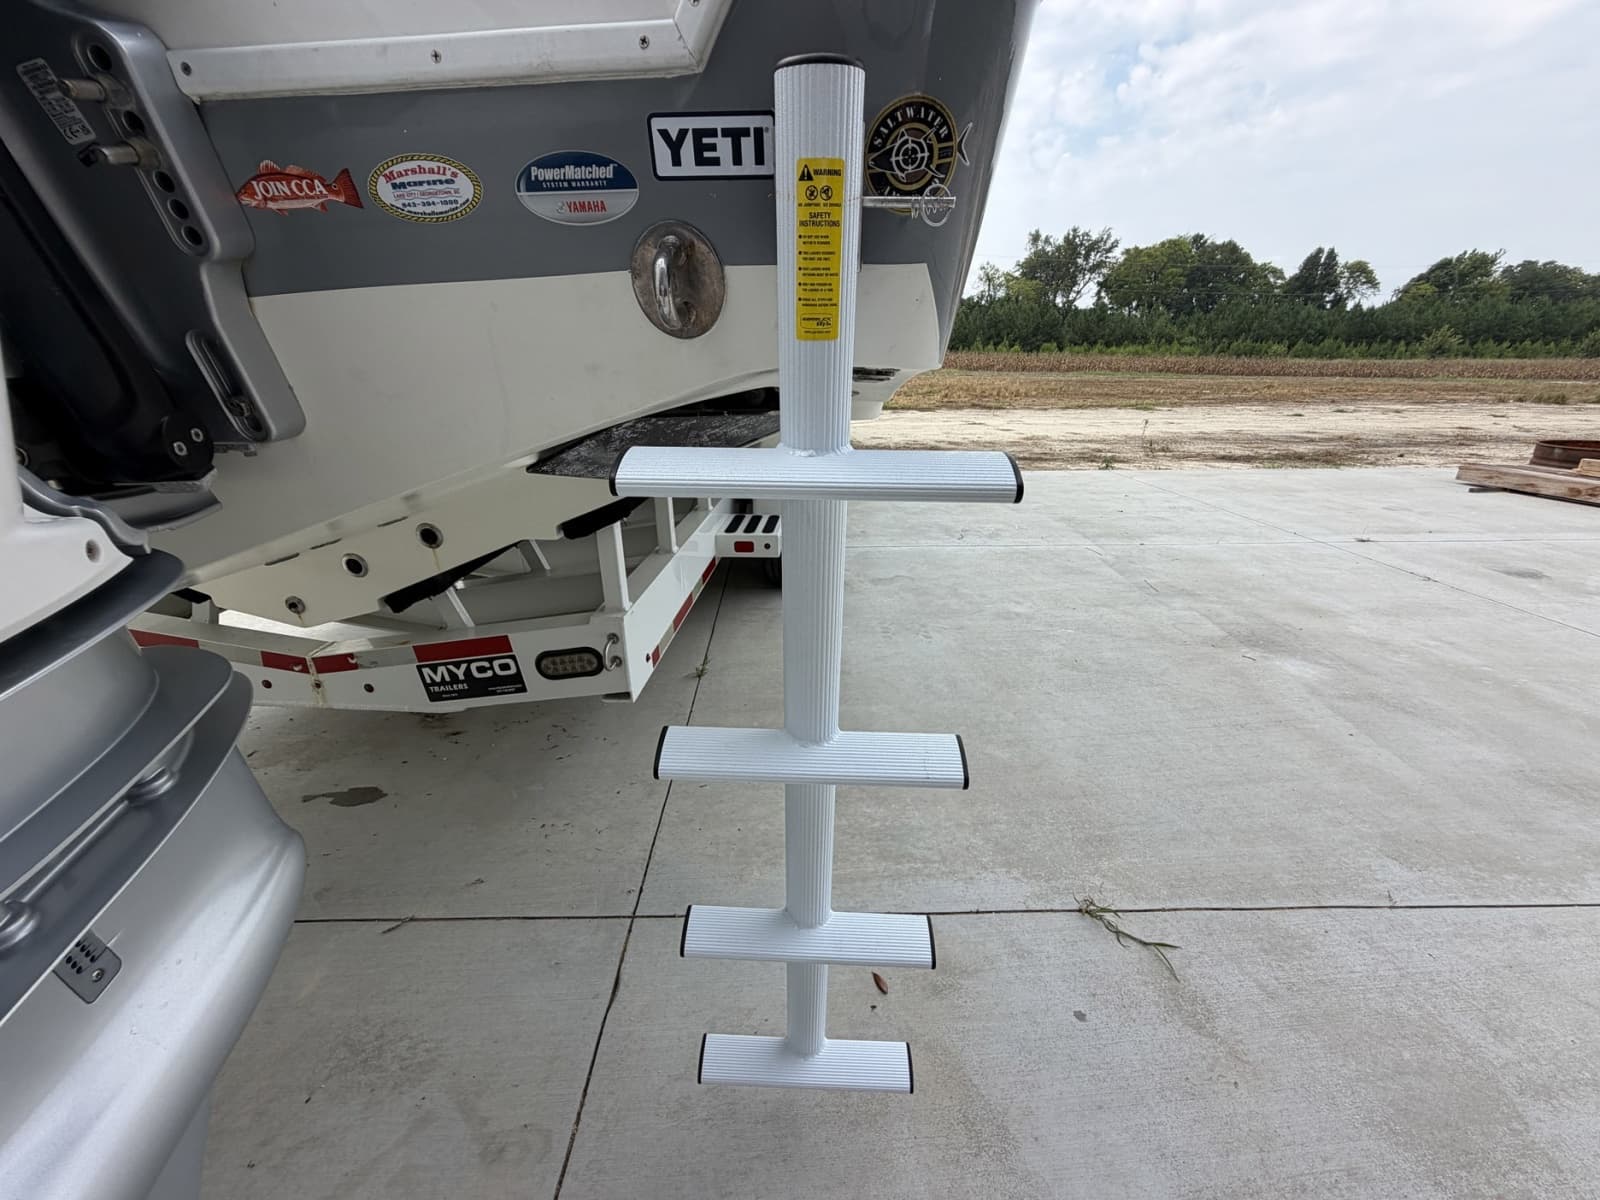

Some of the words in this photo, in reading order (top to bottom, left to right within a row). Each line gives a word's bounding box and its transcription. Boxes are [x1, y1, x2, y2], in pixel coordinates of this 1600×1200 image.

[873, 106, 949, 147] SALTWATER
[656, 126, 765, 167] YETI
[383, 165, 458, 183] Marshall's
[530, 164, 614, 181] PowerMatched
[813, 168, 842, 177] WARNING
[250, 180, 292, 200] JOIN
[290, 179, 329, 197] CCA
[390, 178, 456, 191] Marine
[566, 200, 608, 213] YAMAHA
[808, 211, 832, 219] SAFETY
[799, 220, 841, 228] INSTRUCTIONS
[421, 658, 517, 683] MYCO
[429, 682, 469, 694] TRAILERS
